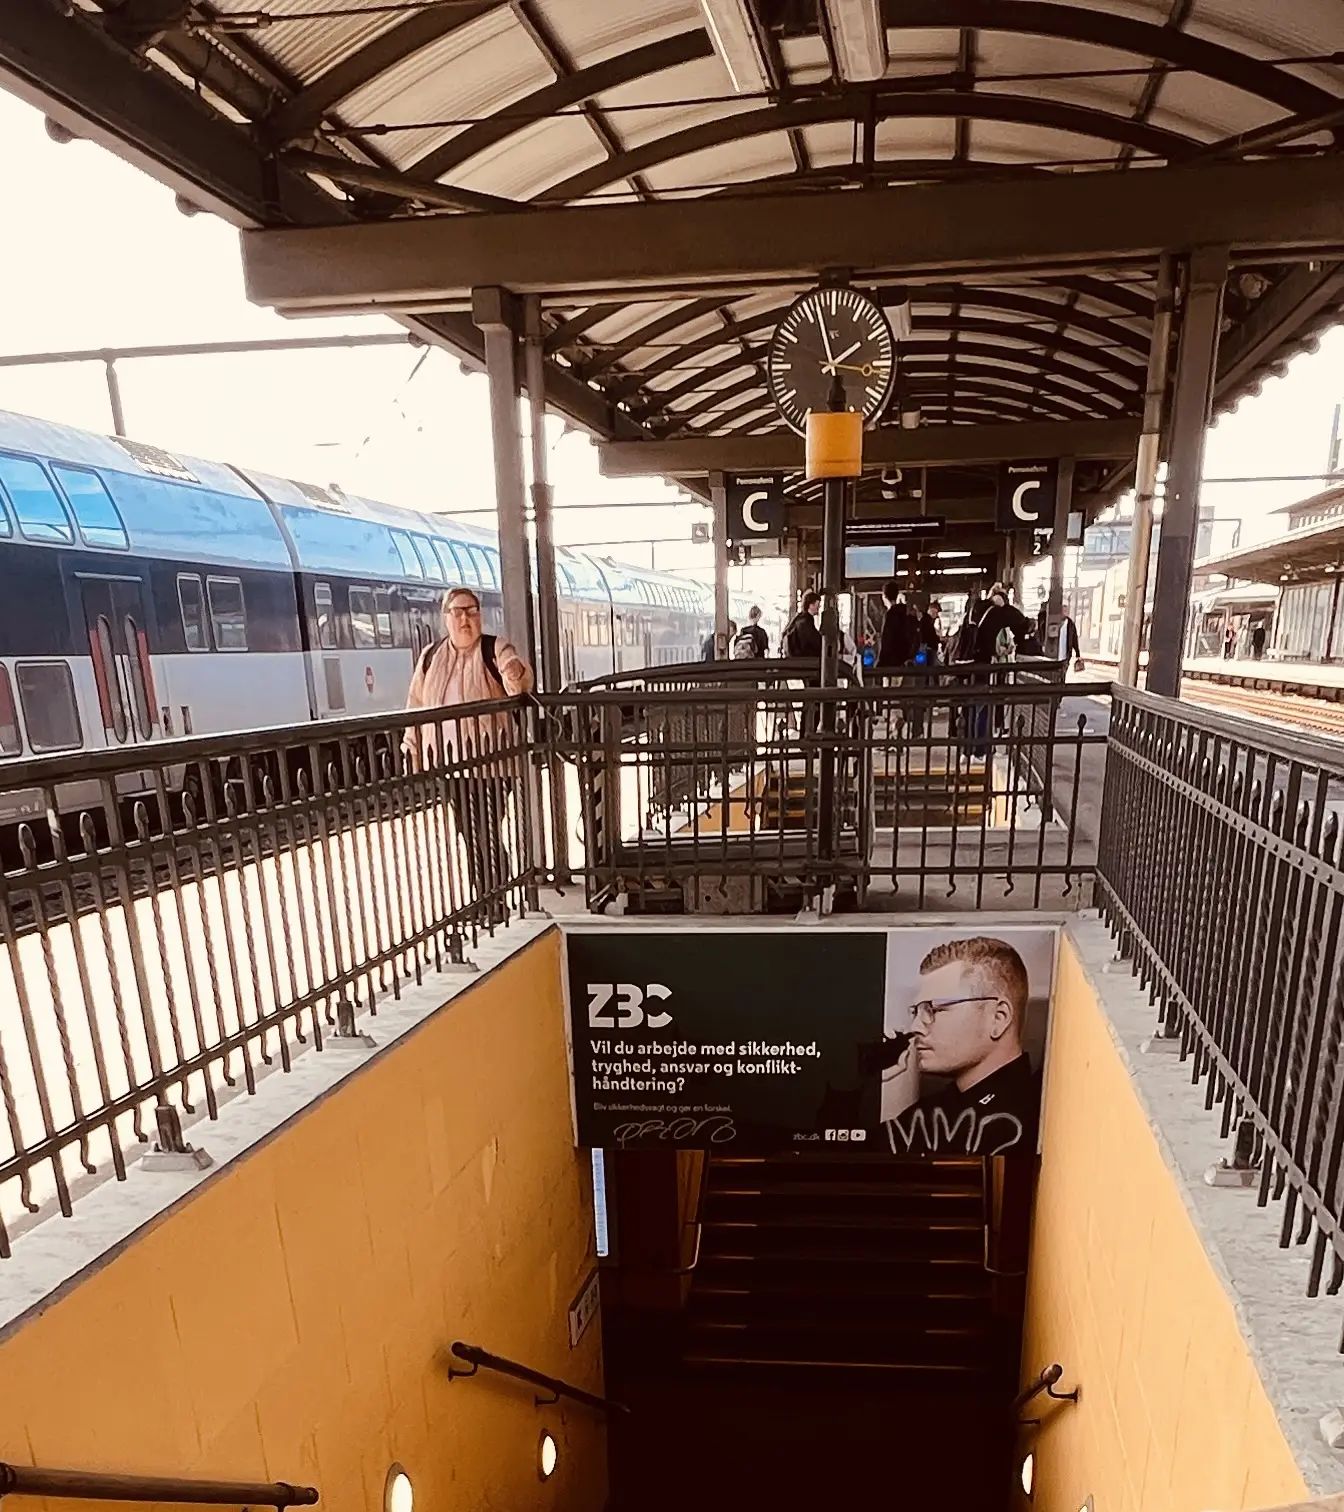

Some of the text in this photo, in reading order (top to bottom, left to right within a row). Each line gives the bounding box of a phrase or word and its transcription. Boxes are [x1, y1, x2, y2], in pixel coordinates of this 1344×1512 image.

[1012, 480, 1041, 521] C
[742, 491, 769, 532] C
[1033, 542, 1042, 555] 2
[586, 983, 674, 1029] ZBC
[590, 1039, 822, 1059] Vil du arbejde med sikkerhed,
[591, 1058, 803, 1077] tryghed, ansvar og konflikt-
[592, 1075, 686, 1095] håndtering?
